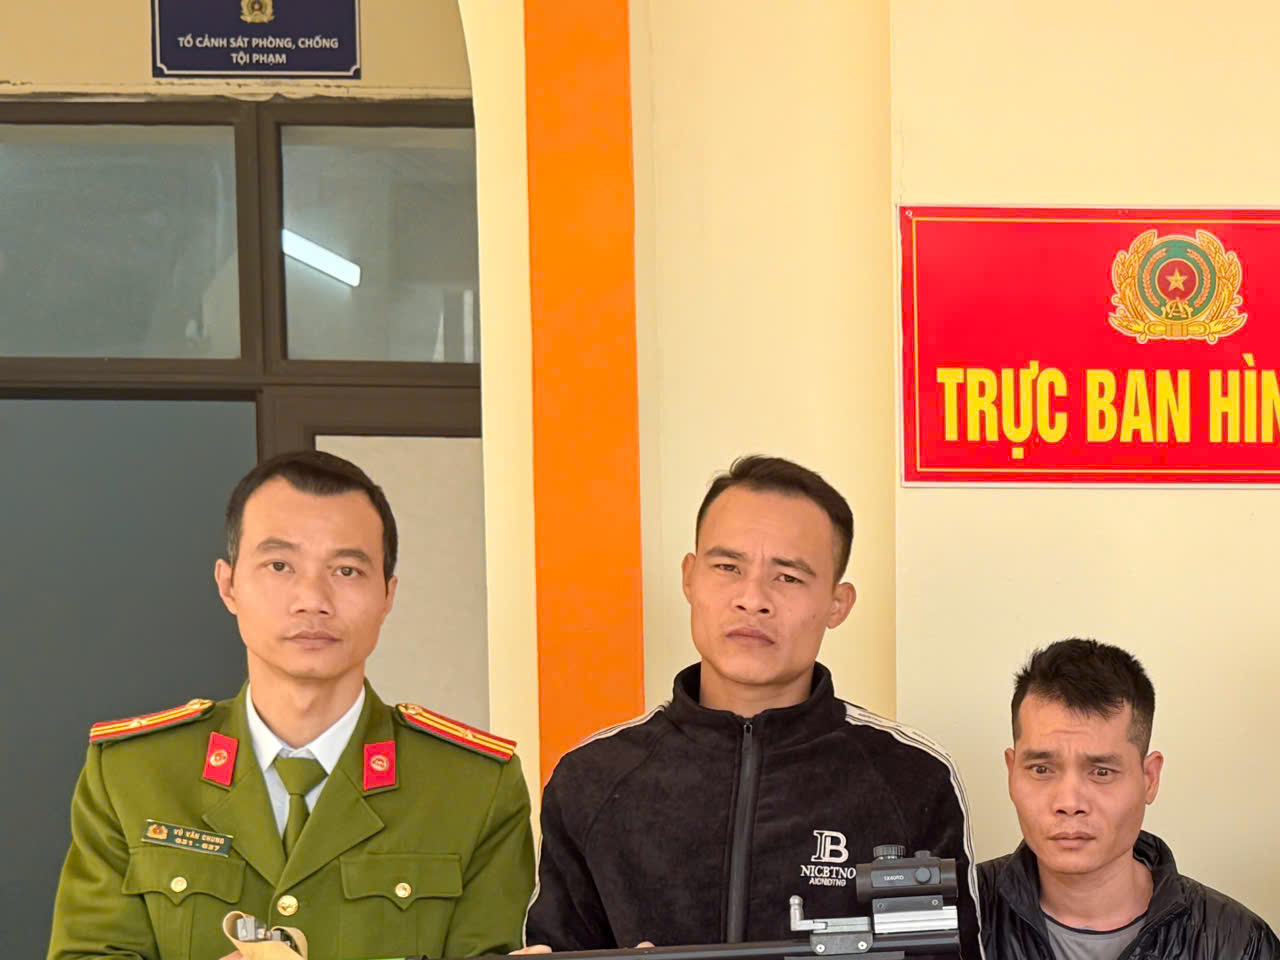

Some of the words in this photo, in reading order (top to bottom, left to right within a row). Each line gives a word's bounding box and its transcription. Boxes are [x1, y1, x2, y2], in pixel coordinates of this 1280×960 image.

[196, 35, 227, 48] CẢNH
[230, 35, 250, 48] SÁT
[252, 35, 296, 50] PHÒNG,
[298, 34, 339, 49] CHỐNG
[231, 51, 250, 65] TỘI
[252, 53, 287, 66] PHẠM
[936, 359, 1068, 460] TRỰC
[1086, 368, 1191, 444] BAN
